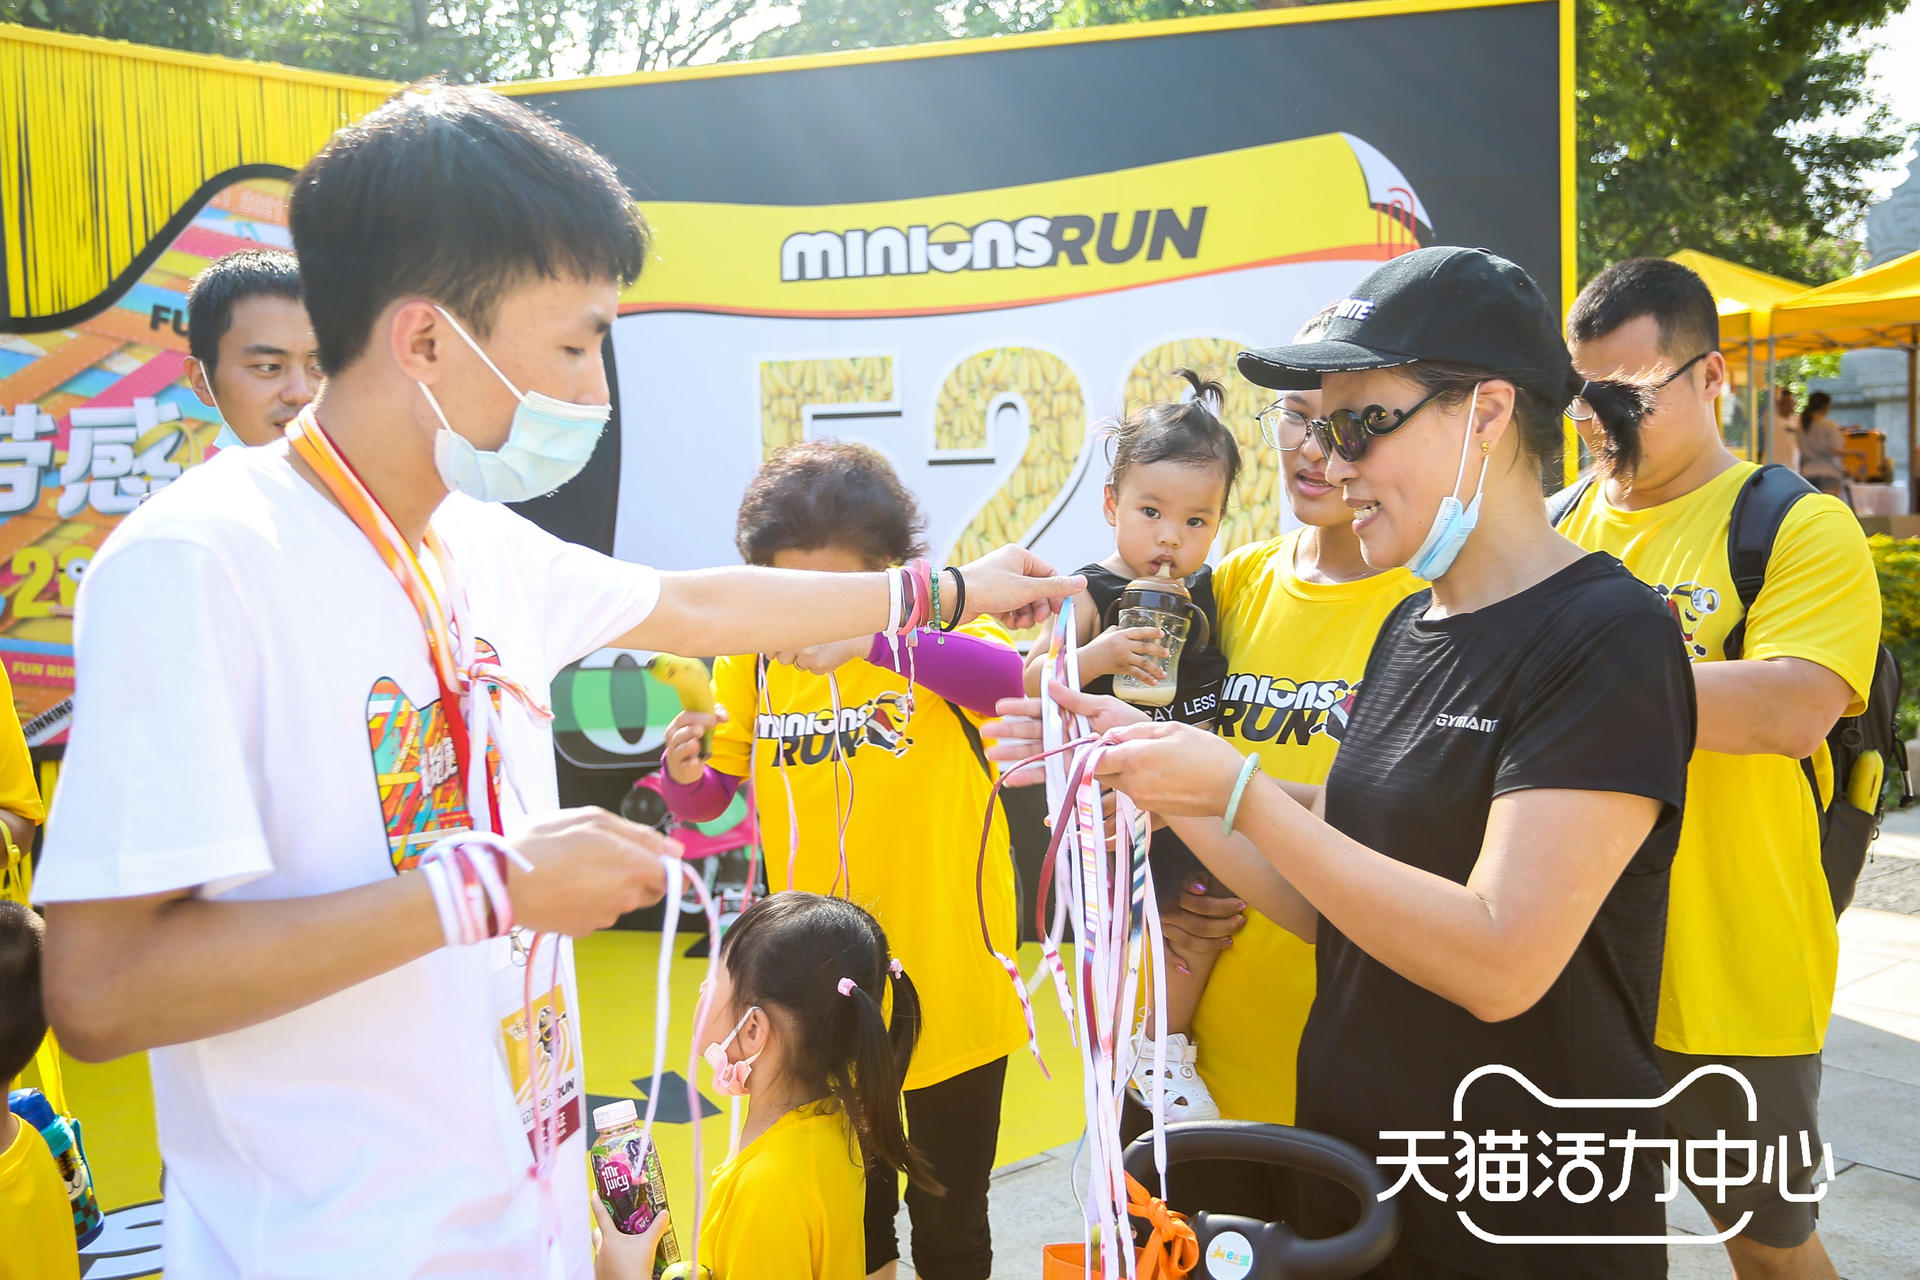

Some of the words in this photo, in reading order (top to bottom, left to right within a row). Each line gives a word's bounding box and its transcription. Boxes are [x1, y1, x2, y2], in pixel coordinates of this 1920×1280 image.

[12, 661, 44, 677] FUN
[1183, 693, 1217, 717] LESS
[1217, 703, 1321, 746] RUN
[771, 729, 861, 768] RUN
[637, 1217, 651, 1230] NFC
